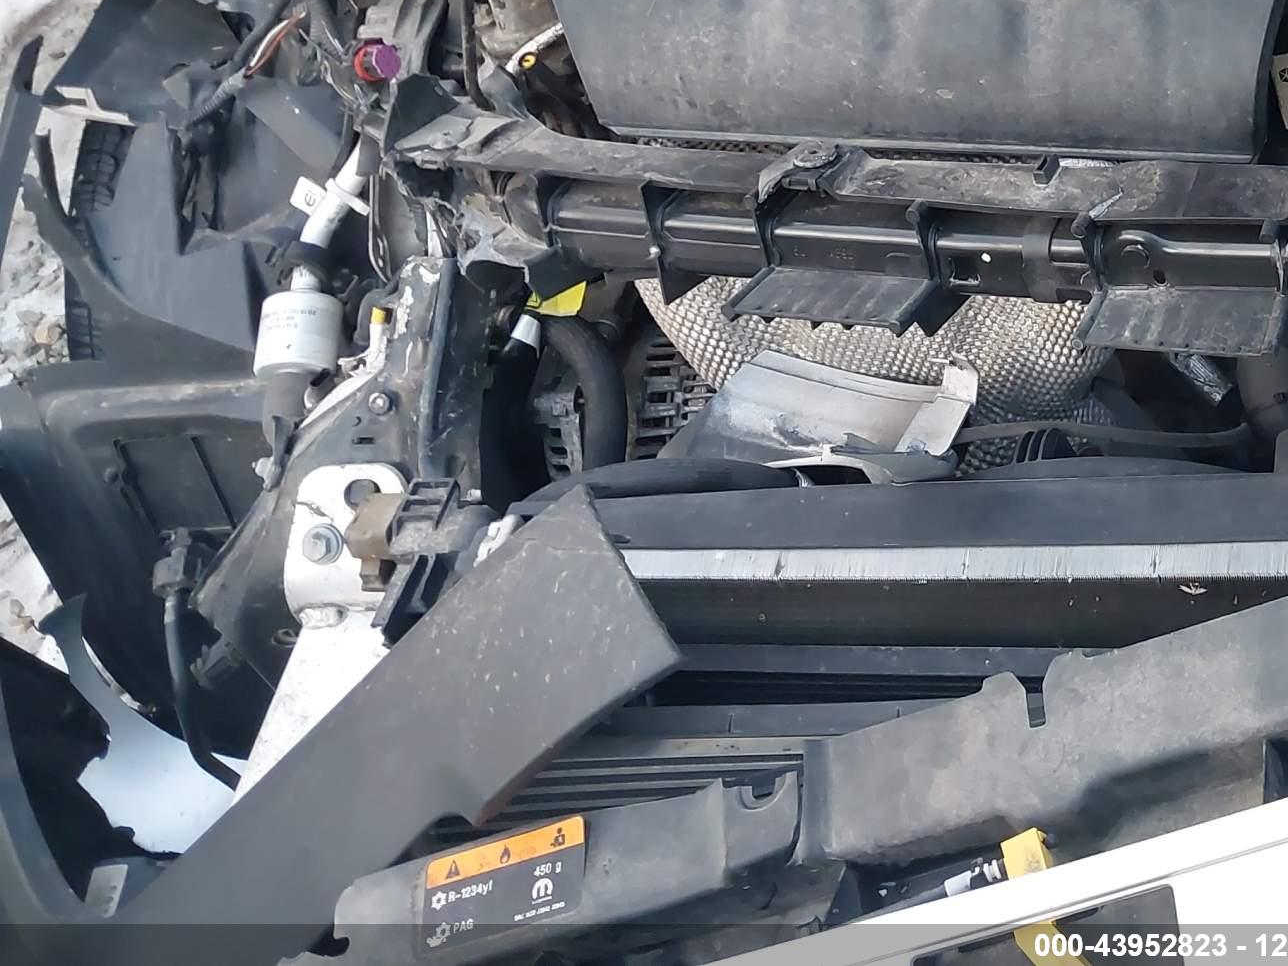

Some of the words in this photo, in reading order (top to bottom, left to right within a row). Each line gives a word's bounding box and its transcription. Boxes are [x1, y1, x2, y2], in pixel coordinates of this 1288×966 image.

[533, 862, 552, 877] 450
[448, 880, 493, 903] R-1234yf
[453, 918, 474, 934] PAG
